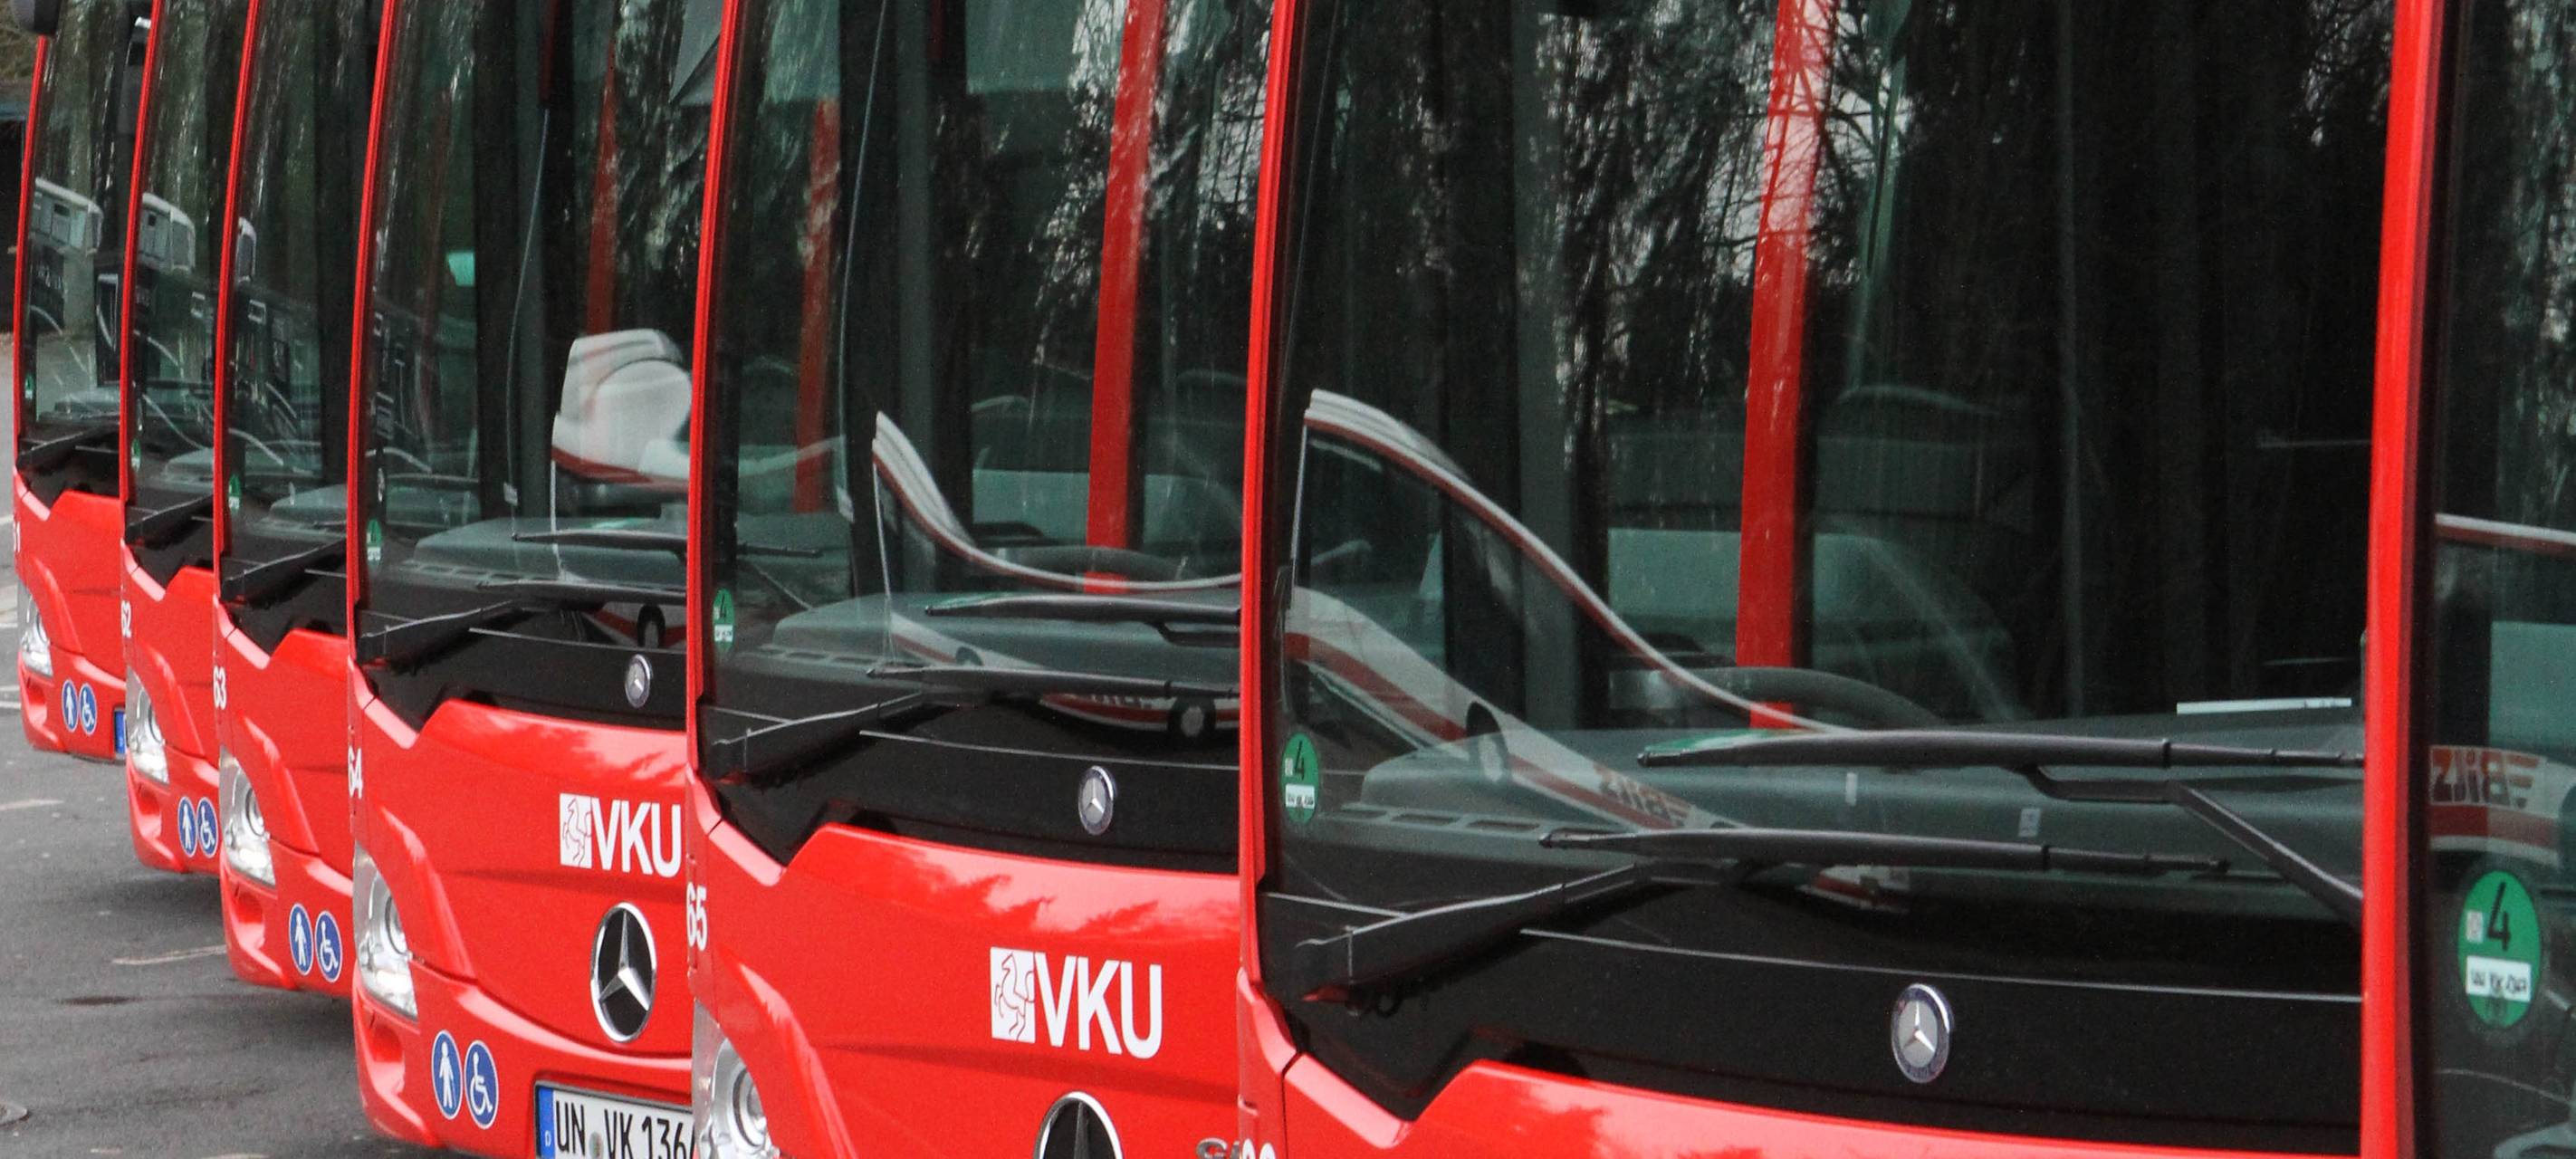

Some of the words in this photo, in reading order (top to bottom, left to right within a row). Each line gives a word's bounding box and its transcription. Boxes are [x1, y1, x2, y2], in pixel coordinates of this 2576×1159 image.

[120, 599, 132, 638] 62
[213, 665, 227, 710] 63
[348, 744, 364, 800] 64
[1295, 740, 1306, 781] 4
[590, 796, 682, 878] VKU
[685, 881, 708, 952] 65
[2486, 881, 2512, 951] 4
[1034, 952, 1163, 1059] VKU
[555, 1100, 586, 1156] UN
[604, 1108, 634, 1159] VK
[641, 1116, 696, 1159] 136
